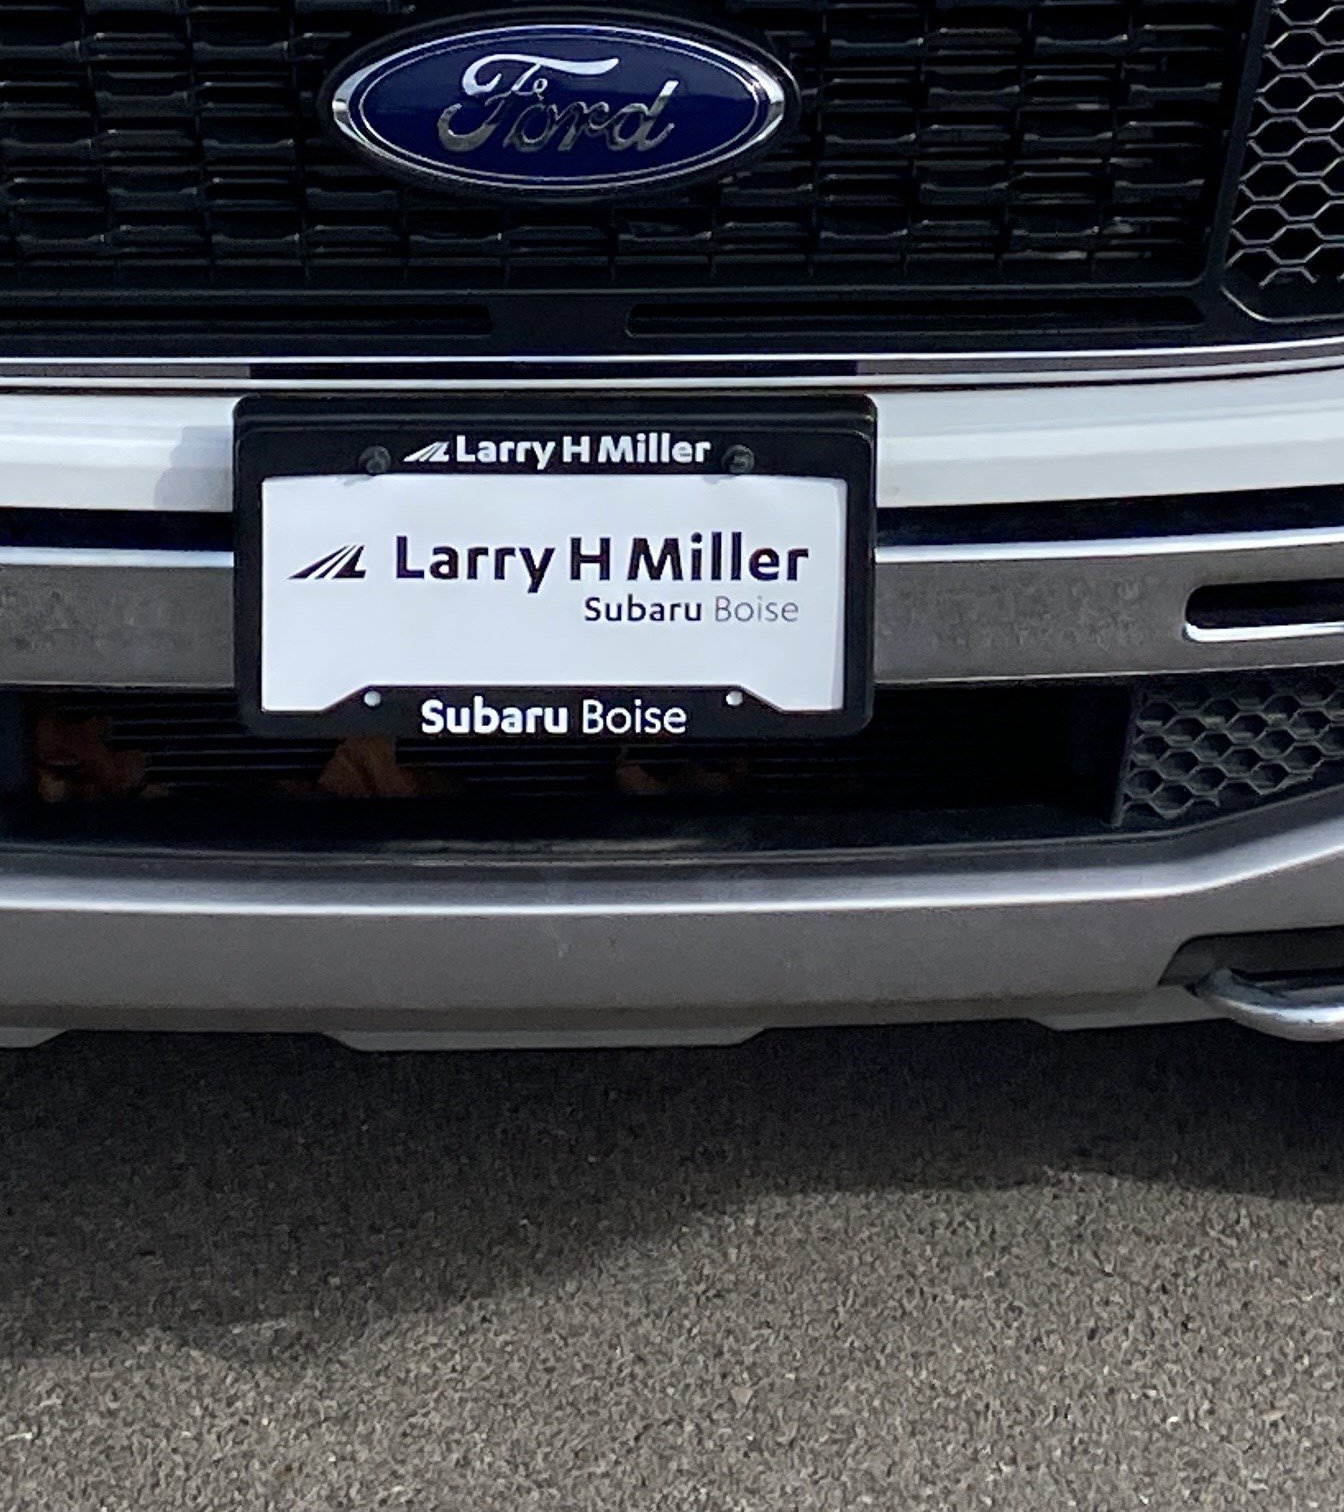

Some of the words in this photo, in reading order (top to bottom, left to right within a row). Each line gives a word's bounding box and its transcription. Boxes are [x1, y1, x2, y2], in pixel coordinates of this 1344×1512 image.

[437, 53, 679, 153] Ford
[457, 435, 556, 469] Larry
[563, 436, 591, 463] H
[597, 433, 711, 463] Miller
[396, 536, 555, 593] Larry
[570, 537, 611, 580] H
[627, 532, 809, 581] Miller
[585, 594, 702, 621] Subaru
[715, 595, 799, 623] Boise
[422, 696, 567, 733] Subaru
[583, 699, 686, 733] Boise
